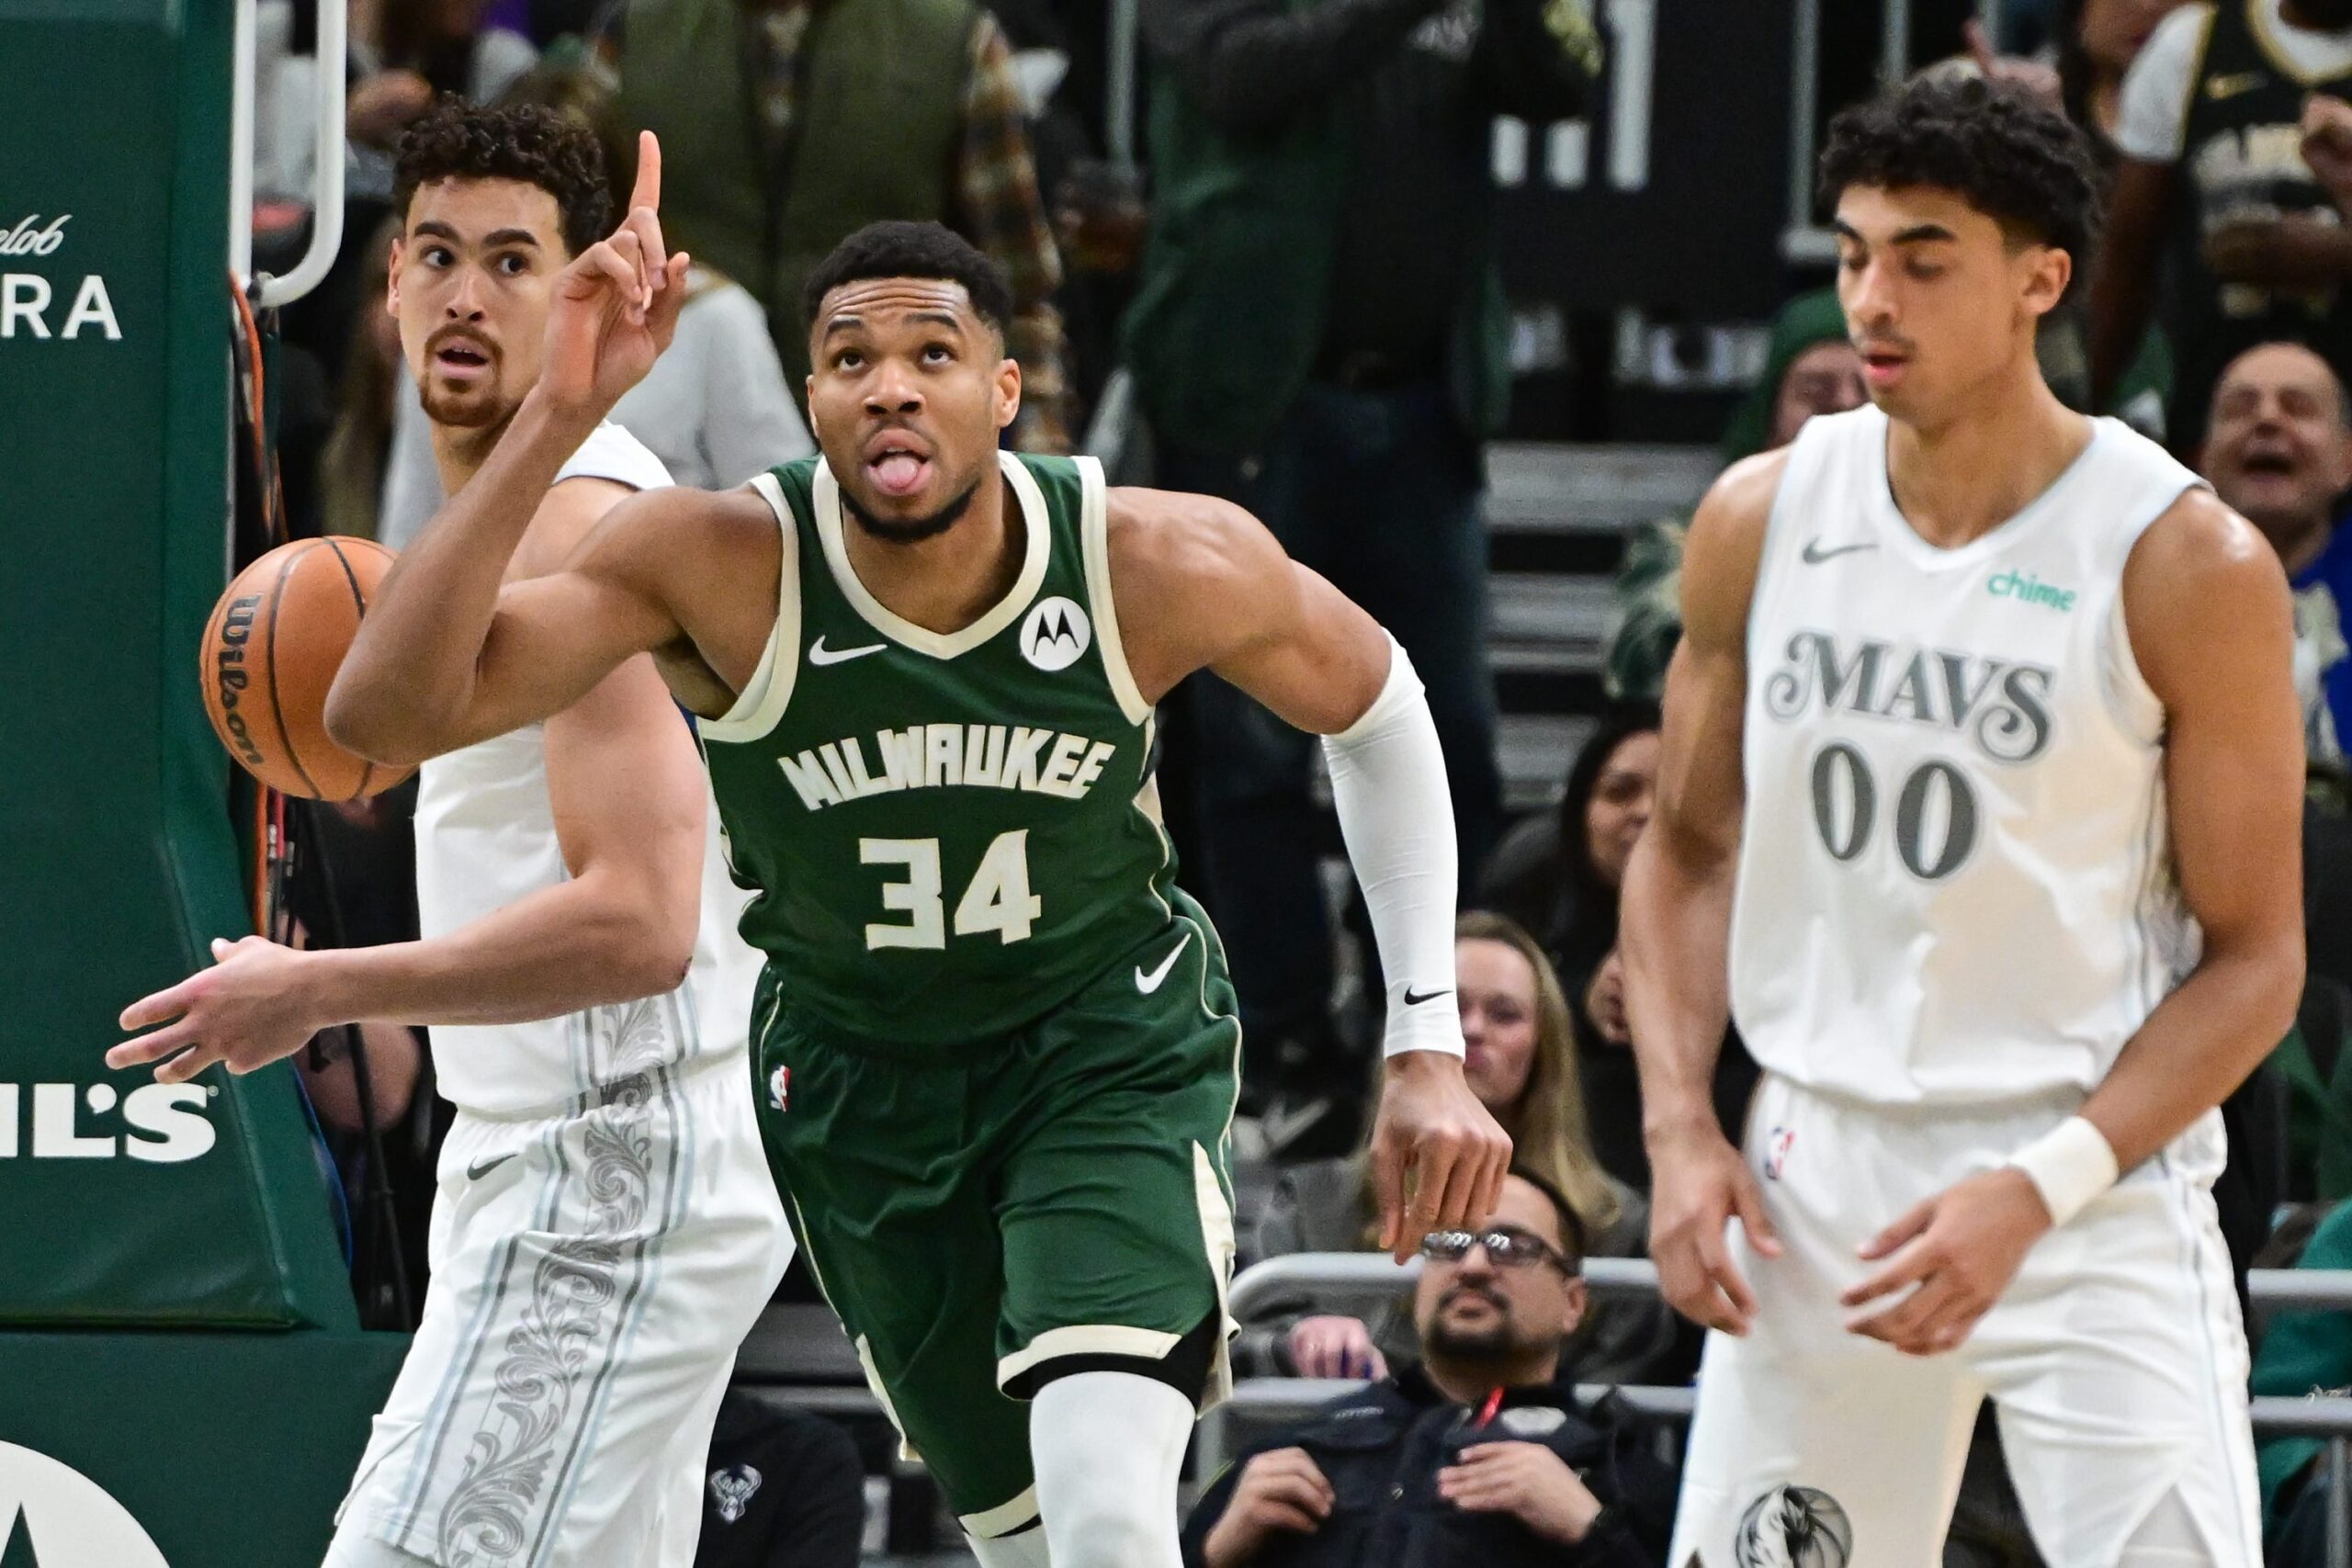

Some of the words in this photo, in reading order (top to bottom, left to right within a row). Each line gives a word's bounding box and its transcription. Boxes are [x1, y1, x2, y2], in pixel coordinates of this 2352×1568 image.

[1, 273, 122, 340] RA
[1987, 568, 2077, 613] chime
[219, 592, 265, 764] Wilson
[1764, 627, 2058, 763] MAVS
[777, 723, 1116, 811] MILWAUKEE
[1811, 742, 1978, 879] 00
[859, 829, 1042, 951] 34
[0, 1082, 217, 1163] L'S
